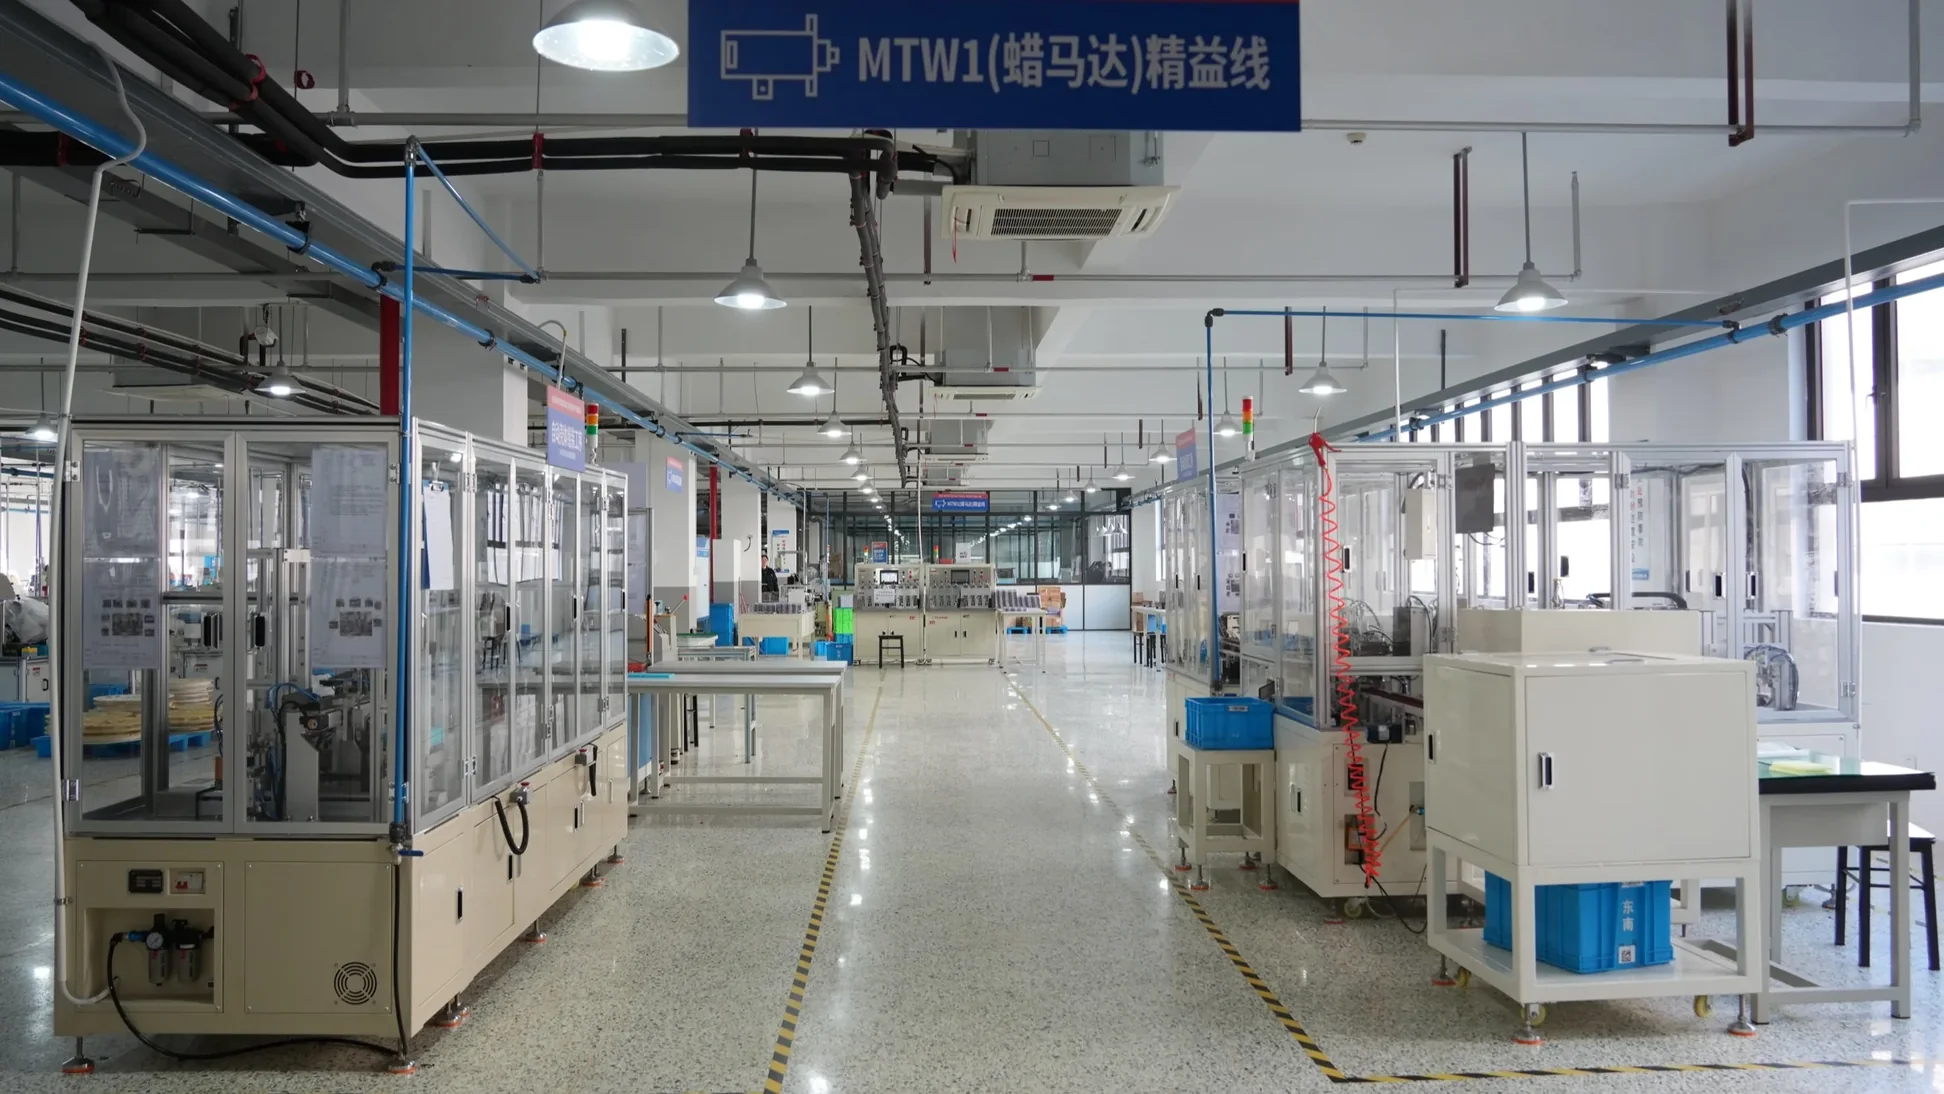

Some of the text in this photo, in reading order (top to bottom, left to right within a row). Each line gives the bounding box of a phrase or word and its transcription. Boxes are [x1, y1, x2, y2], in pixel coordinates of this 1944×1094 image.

[858, 32, 1270, 94] MTW1(蜡马达)精益线
[1622, 899, 1634, 932] 东南
